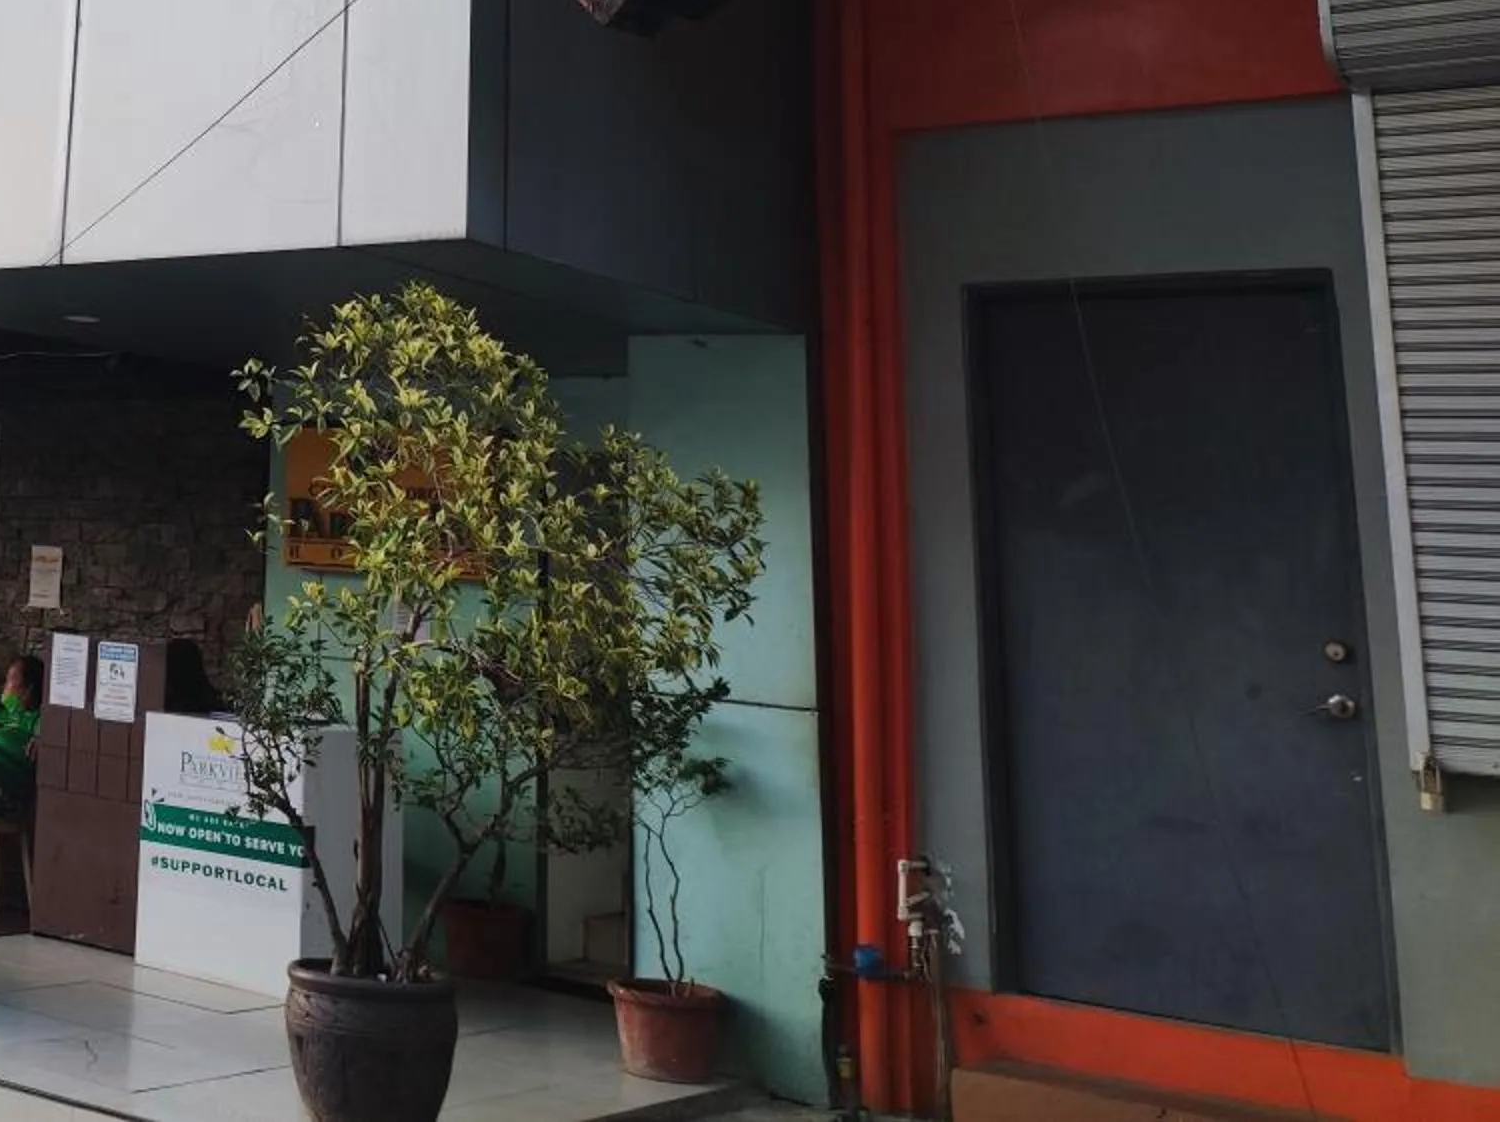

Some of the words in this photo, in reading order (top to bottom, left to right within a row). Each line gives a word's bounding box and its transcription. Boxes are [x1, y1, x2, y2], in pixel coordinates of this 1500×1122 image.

[157, 822, 185, 837] NOW
[188, 827, 221, 843] OPEN
[225, 832, 241, 846] TO
[245, 837, 285, 855] SERVE
[151, 856, 288, 891] #SUPPORTLOCAL
